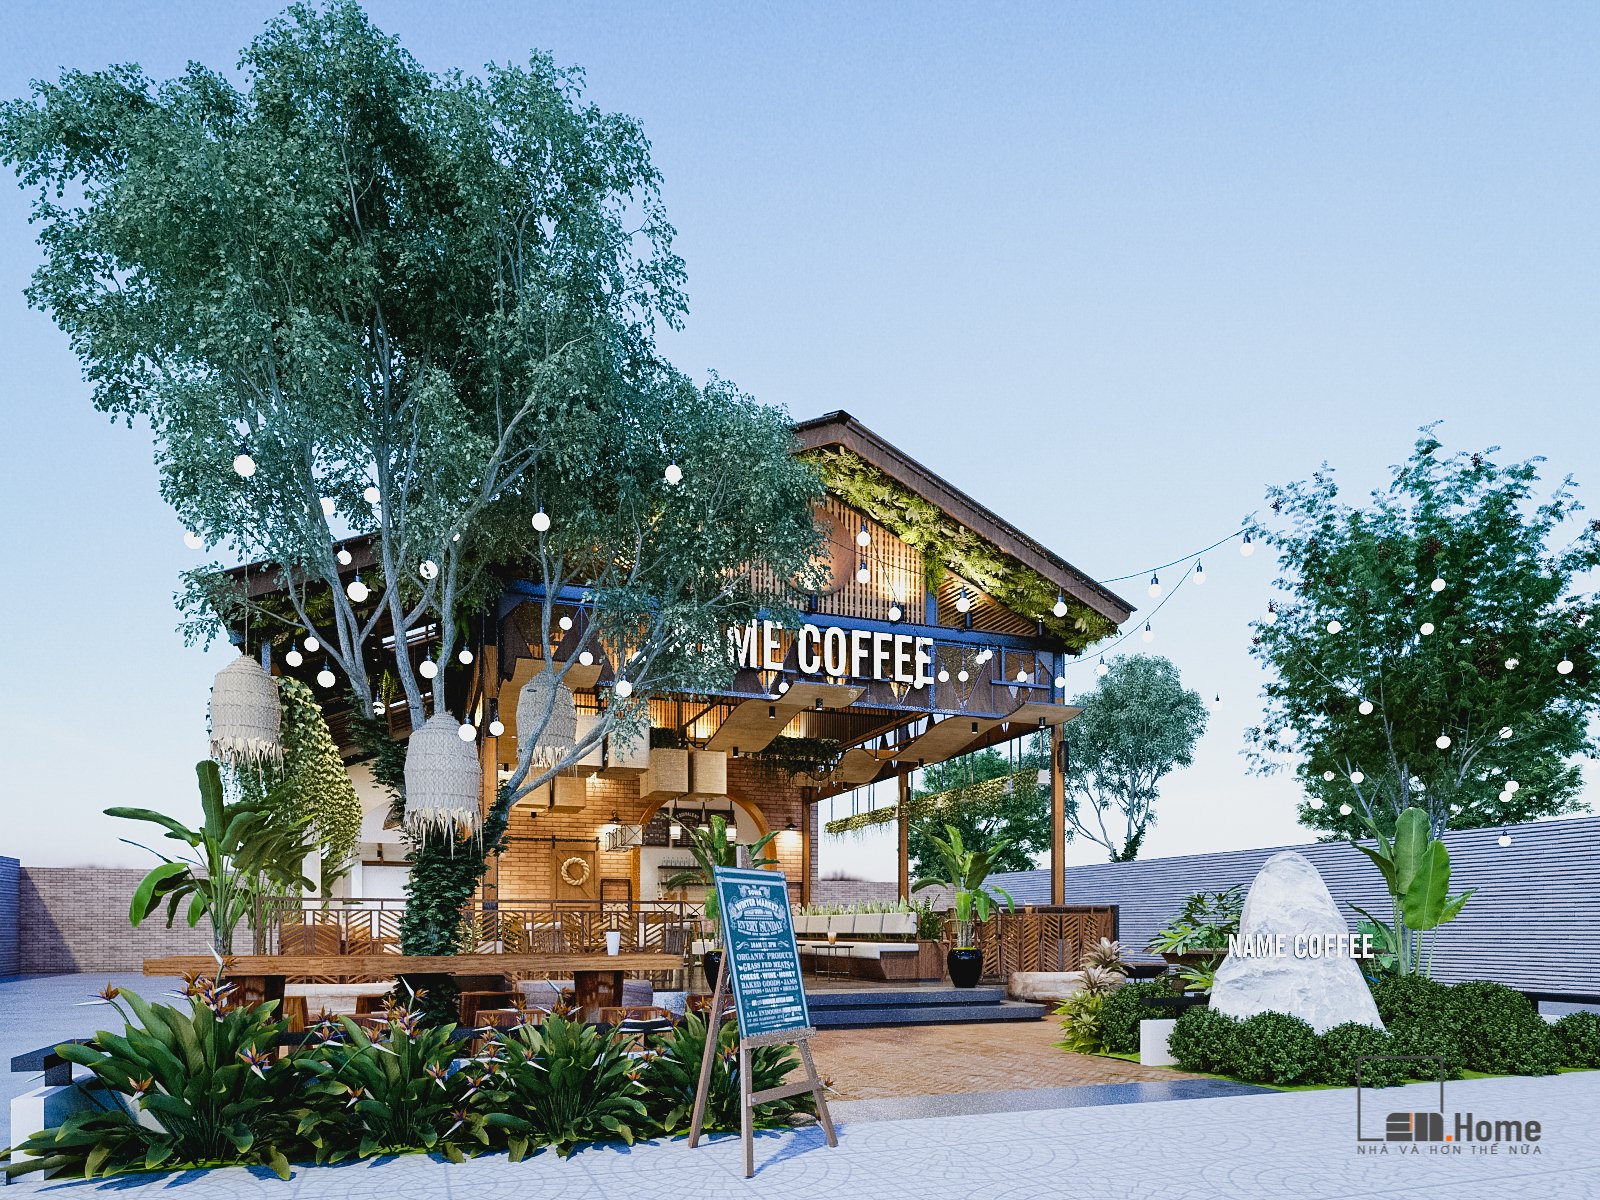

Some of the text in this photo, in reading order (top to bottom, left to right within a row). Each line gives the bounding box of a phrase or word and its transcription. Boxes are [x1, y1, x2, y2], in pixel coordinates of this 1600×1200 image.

[799, 623, 934, 685] COFFEE
[756, 899, 778, 911] MARKET
[738, 921, 782, 932] EVERY SUNDAY
[1228, 934, 1374, 959] NAME COFFEE
[743, 962, 760, 972] GRASS
[773, 961, 790, 969] MEATS
[740, 973, 760, 981] CHEESE
